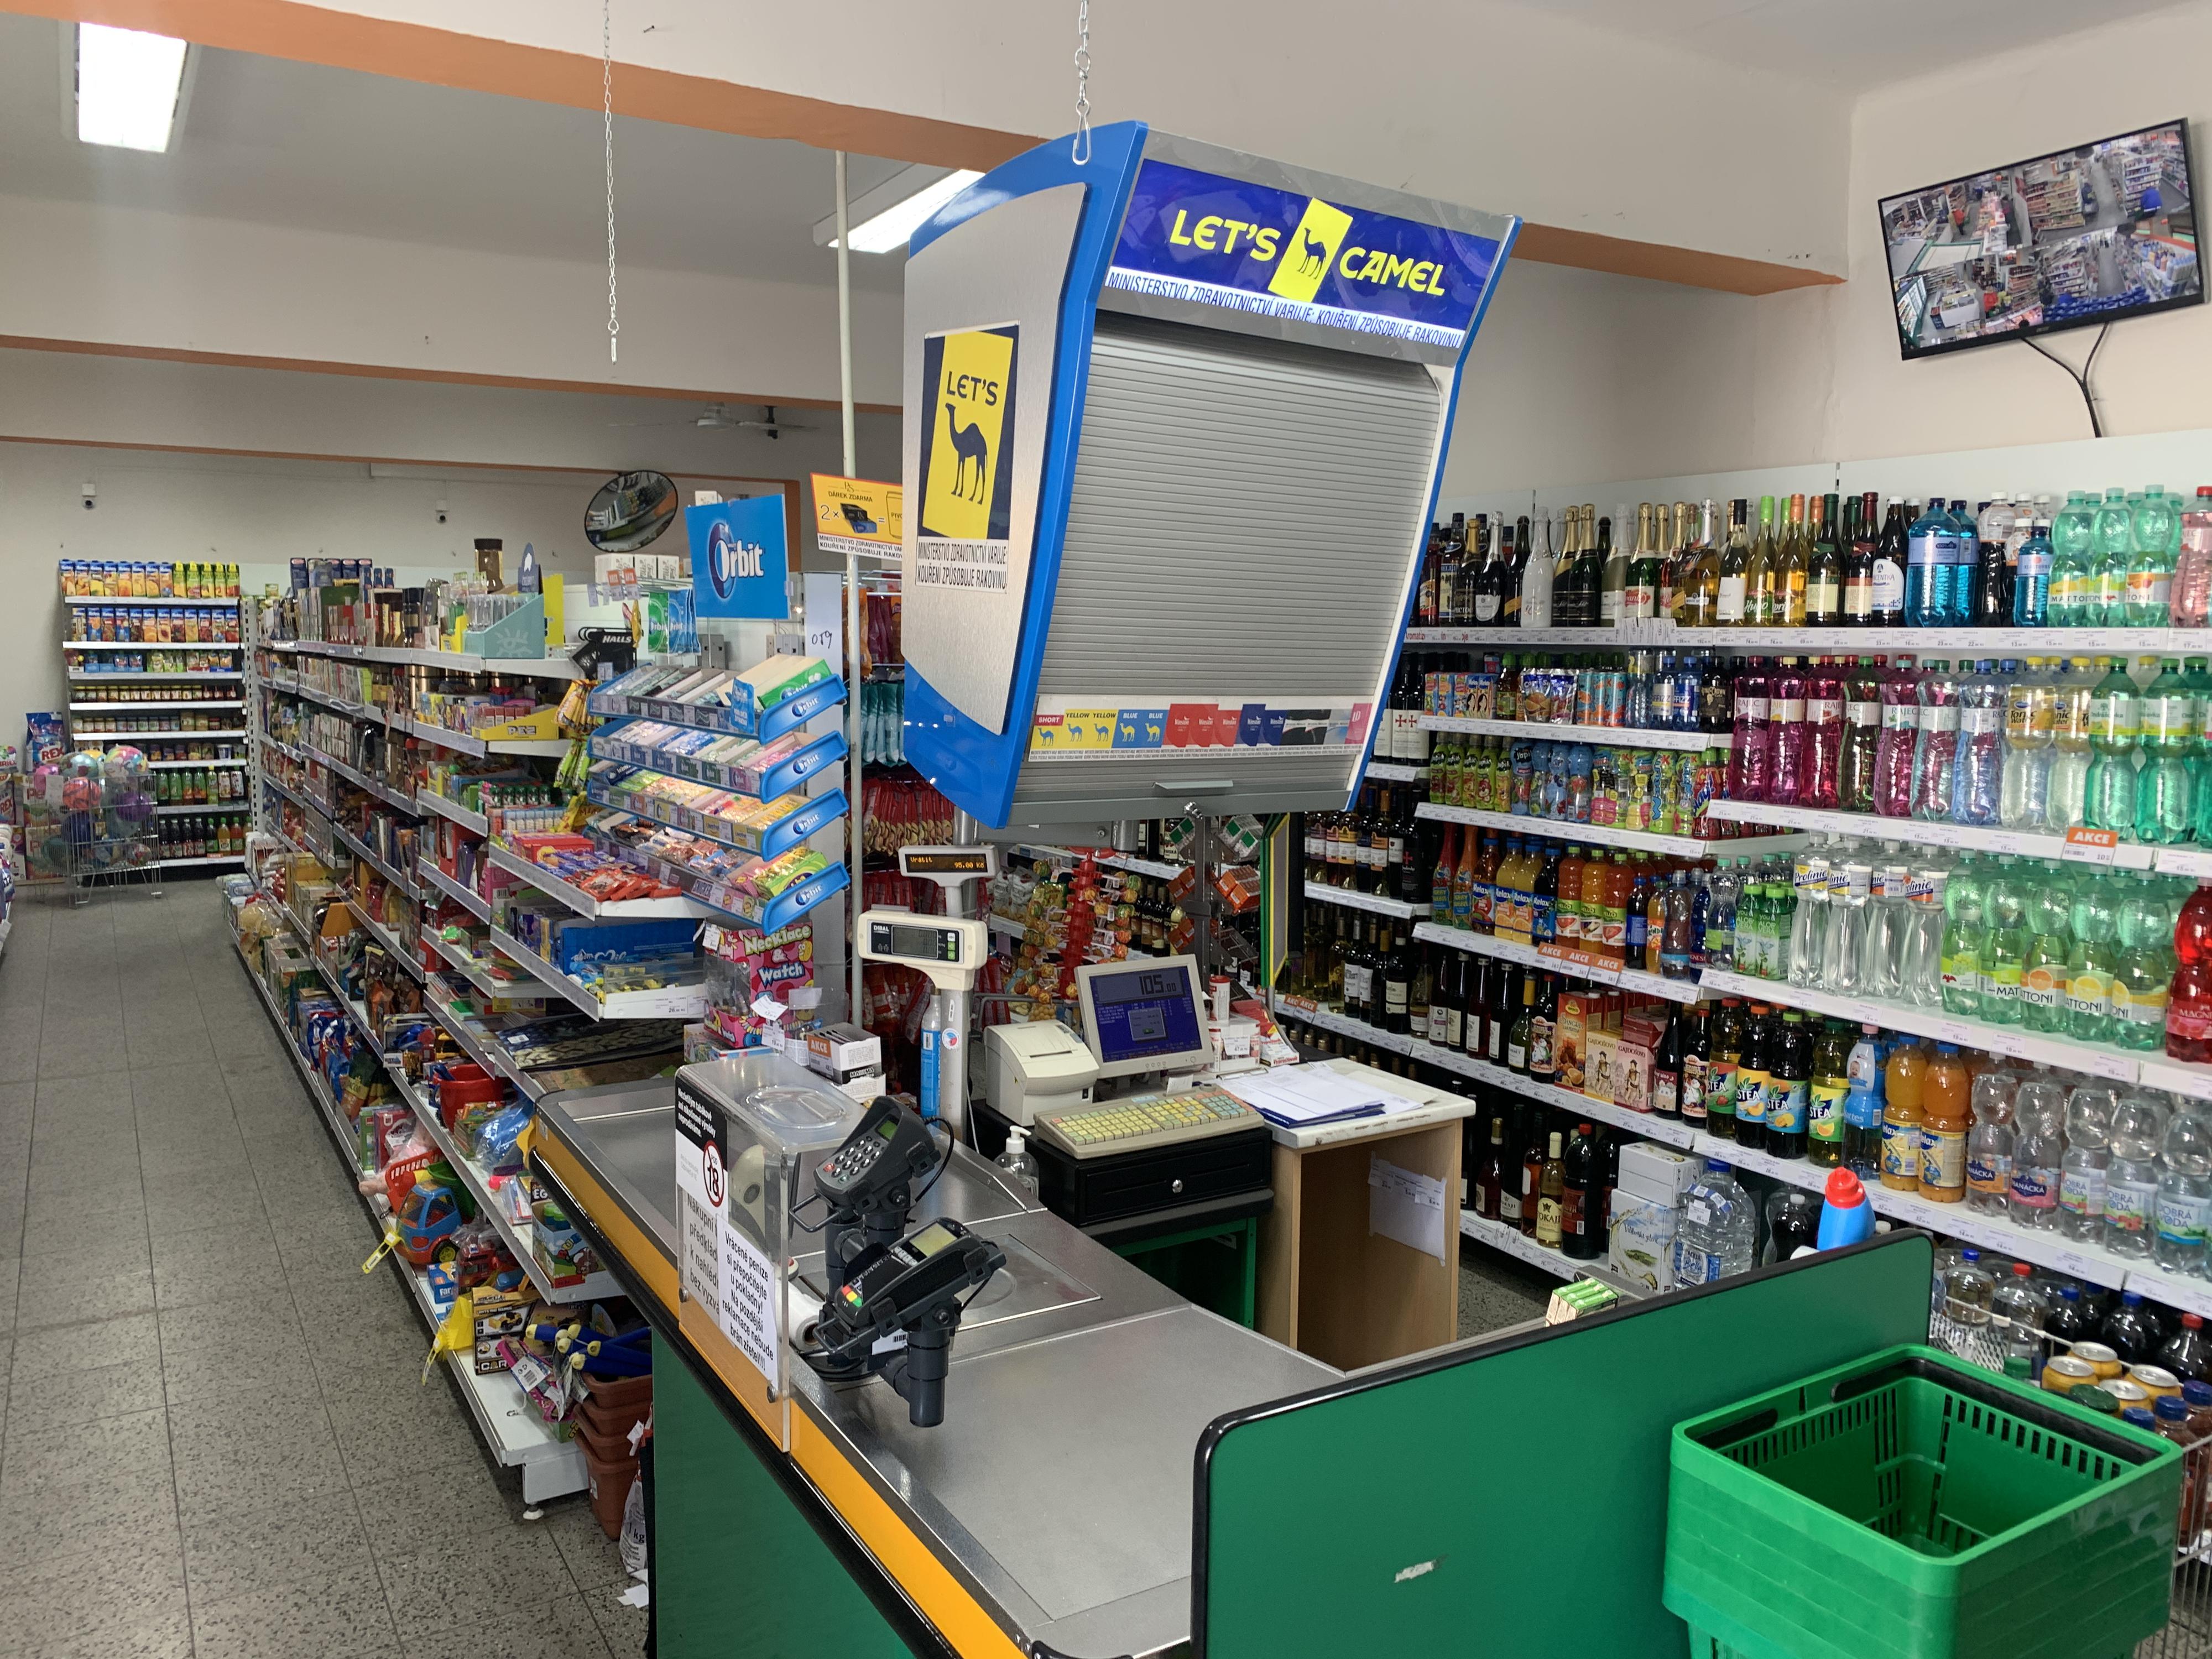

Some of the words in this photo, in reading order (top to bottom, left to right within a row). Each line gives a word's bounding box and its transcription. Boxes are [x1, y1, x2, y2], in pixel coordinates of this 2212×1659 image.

[1169, 208, 1281, 262] LET'S
[1339, 247, 1446, 296] CAMEL
[1108, 271, 1188, 300] MINISTERSTVO
[1190, 286, 1274, 316] ZDRAVOTNICTVÍ
[1317, 309, 1359, 331] KOUŘENÍ
[1359, 315, 1411, 340] ZPŮSOBUJE
[1413, 325, 1462, 348] RAKOVINU
[946, 371, 999, 406] LET'S
[828, 490, 847, 499] DÁREK
[849, 493, 873, 503] ZDARMA
[819, 535, 854, 545] MINISTERSTVO
[855, 540, 893, 551] ZDRAVOTNICTVÍ
[820, 540, 846, 551] KOUŘENÍ
[848, 544, 882, 557] ZPŮSOBUJE
[709, 523, 765, 598] Orbit
[918, 542, 950, 561] MINISTERSTVO
[951, 541, 987, 564] ZDRAVOTNICTVÍ
[917, 562, 942, 584] KOUŘENÍ
[942, 565, 975, 587] ZPŮSOBUJE
[976, 570, 1006, 590] RAKOVINU
[602, 635, 632, 643] HALLS
[792, 697, 819, 717] Orbit
[507, 725, 536, 735] PEZ
[793, 754, 820, 774] Orbit
[793, 813, 820, 834] Orbit
[2073, 831, 2111, 844] AKCE
[1795, 870, 1827, 882] Prolinie
[795, 884, 822, 906] Orbit
[1473, 884, 1489, 895] Relax
[1496, 888, 1511, 899] Relax
[1514, 892, 1531, 903] Relax
[1533, 896, 1550, 906] Relax
[771, 947, 786, 963] &
[1541, 946, 1562, 957] AKCE
[1568, 952, 1590, 963] AKCE
[1597, 958, 1619, 969] AKCE
[758, 962, 805, 988] Watch
[811, 1039, 828, 1053] AKCE
[1737, 1089, 1760, 1101] STEA
[1767, 1099, 1790, 1110] STEA
[1809, 1107, 1832, 1119] STEA
[1882, 1123, 1896, 1135] elax
[1921, 1135, 1935, 1147] elax
[707, 1163, 719, 1197] 18
[534, 1189, 548, 1199] EG
[690, 1222, 717, 1262] předklád
[725, 1231, 748, 1262] Vrácené
[727, 1253, 732, 1267] si
[690, 1267, 701, 1292] bez
[735, 1281, 763, 1314] pokladny!
[731, 1288, 738, 1304] Na
[739, 1301, 763, 1333] pozdější
[722, 1299, 750, 1337] reklamace
[751, 1327, 774, 1360] nebude
[730, 1322, 743, 1345] brán
